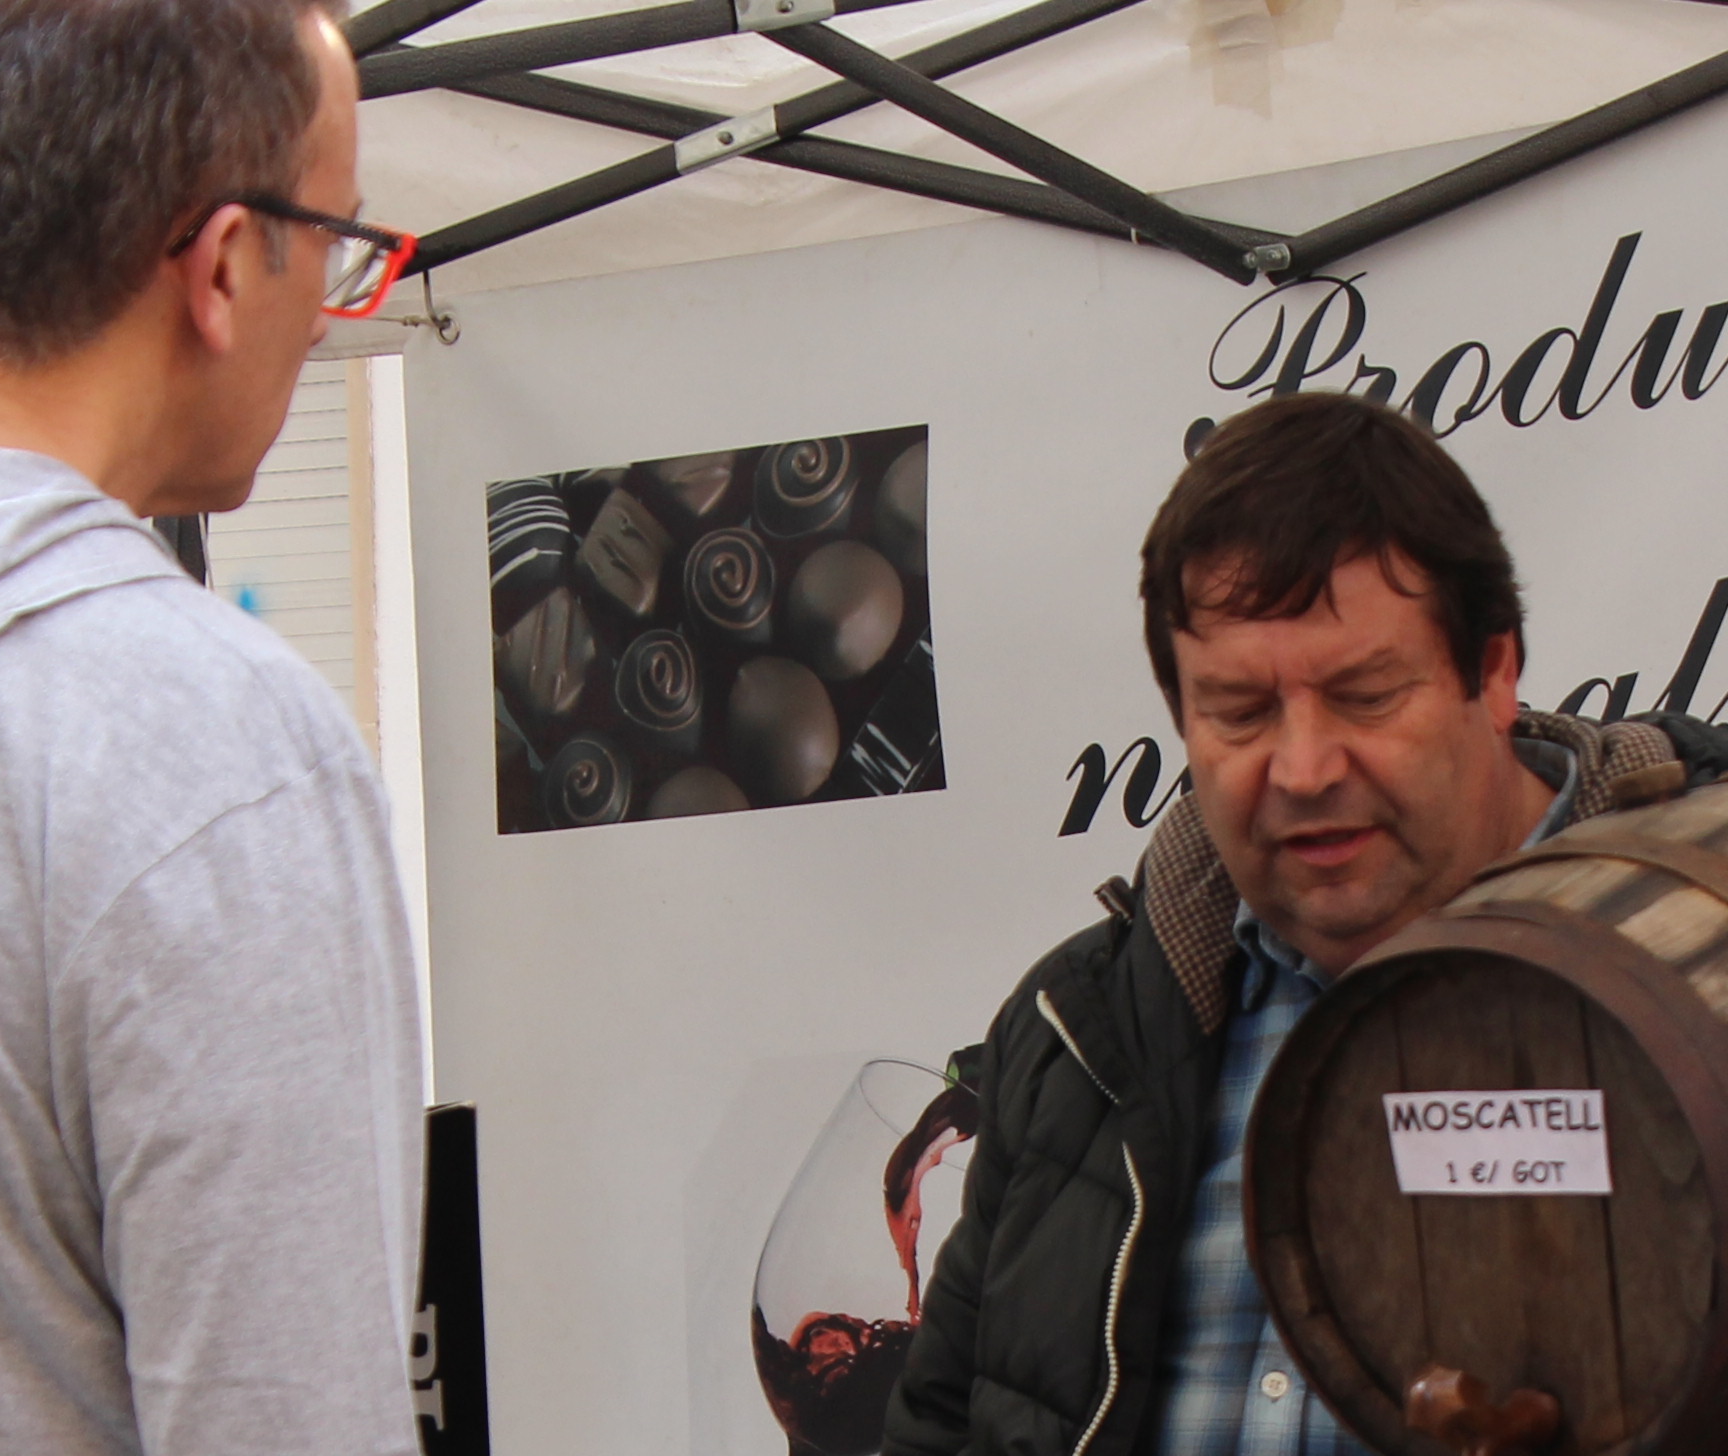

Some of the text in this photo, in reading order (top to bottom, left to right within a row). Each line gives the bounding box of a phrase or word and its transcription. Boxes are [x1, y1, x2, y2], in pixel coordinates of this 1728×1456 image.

[1391, 1097, 1601, 1132] MOSCATELL
[1446, 1160, 1458, 1183] 1
[1512, 1159, 1566, 1184] GOT
